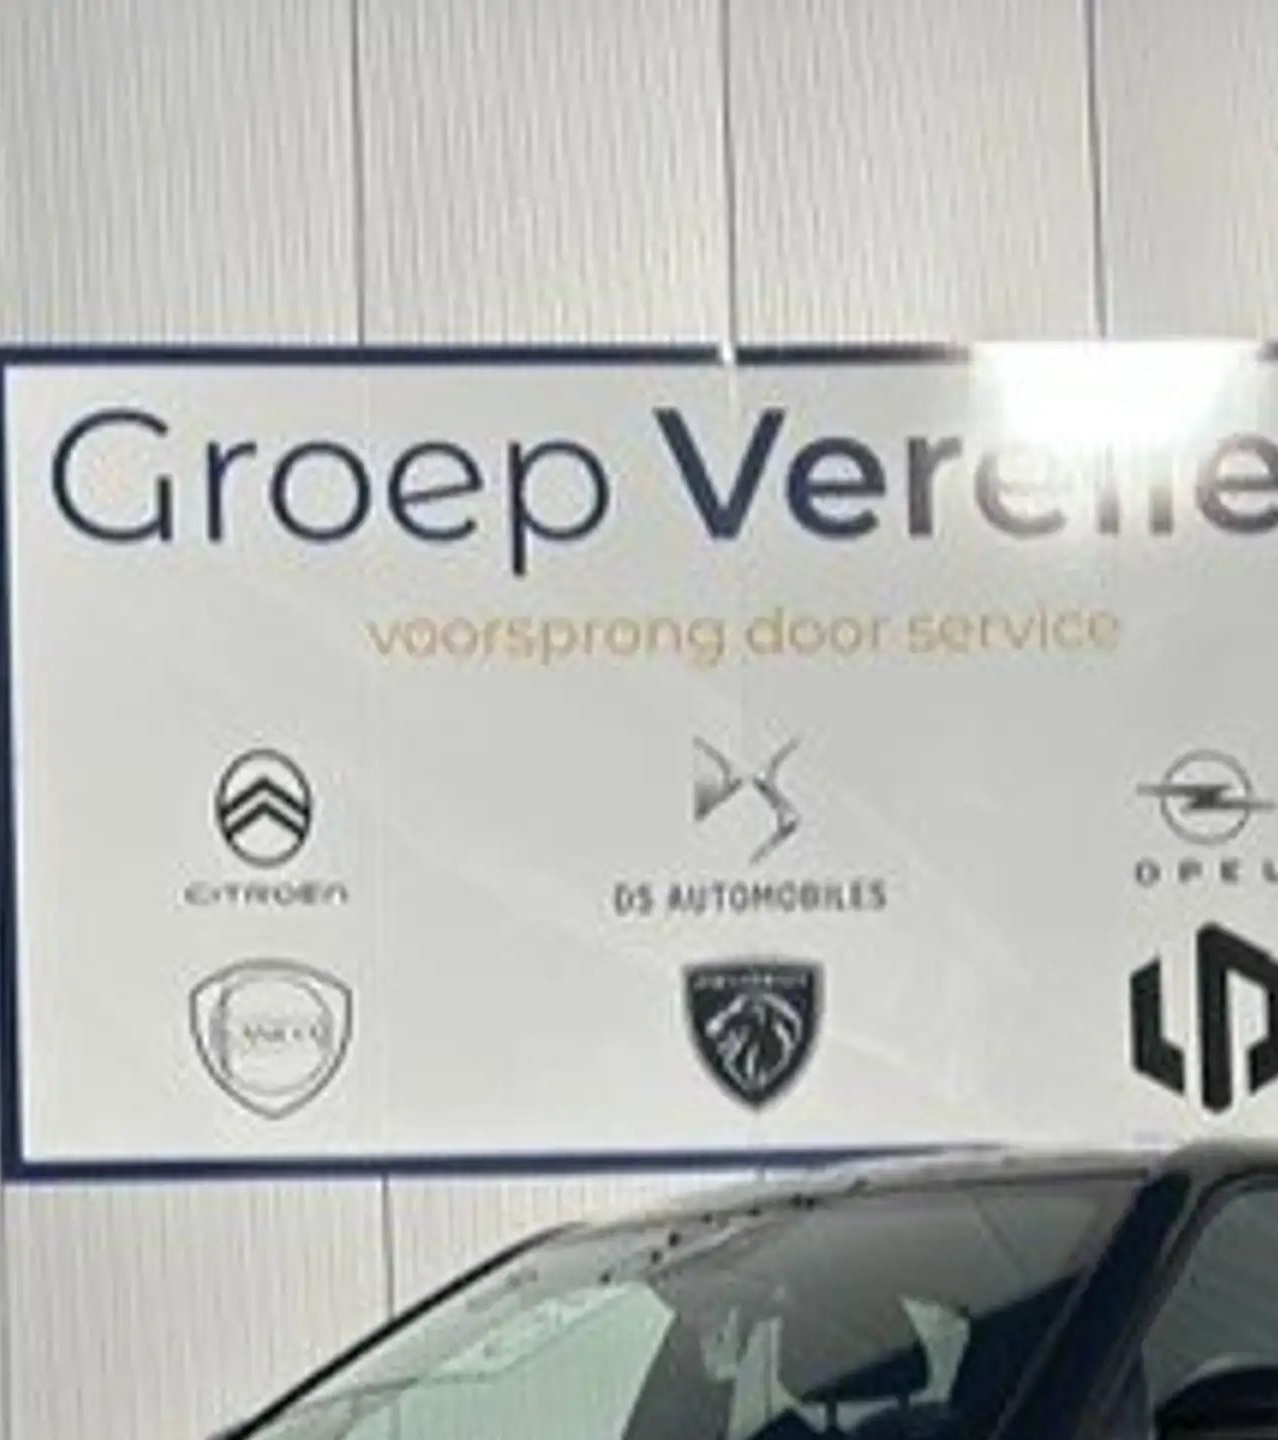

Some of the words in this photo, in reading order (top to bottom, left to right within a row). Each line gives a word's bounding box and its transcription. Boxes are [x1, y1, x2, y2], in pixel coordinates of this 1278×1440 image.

[50, 406, 611, 578] Groep
[370, 614, 726, 668] voorsprong
[745, 606, 891, 654] door
[907, 604, 1121, 654] service
[613, 880, 654, 916] DS
[666, 878, 889, 915] AUTOMOBILES
